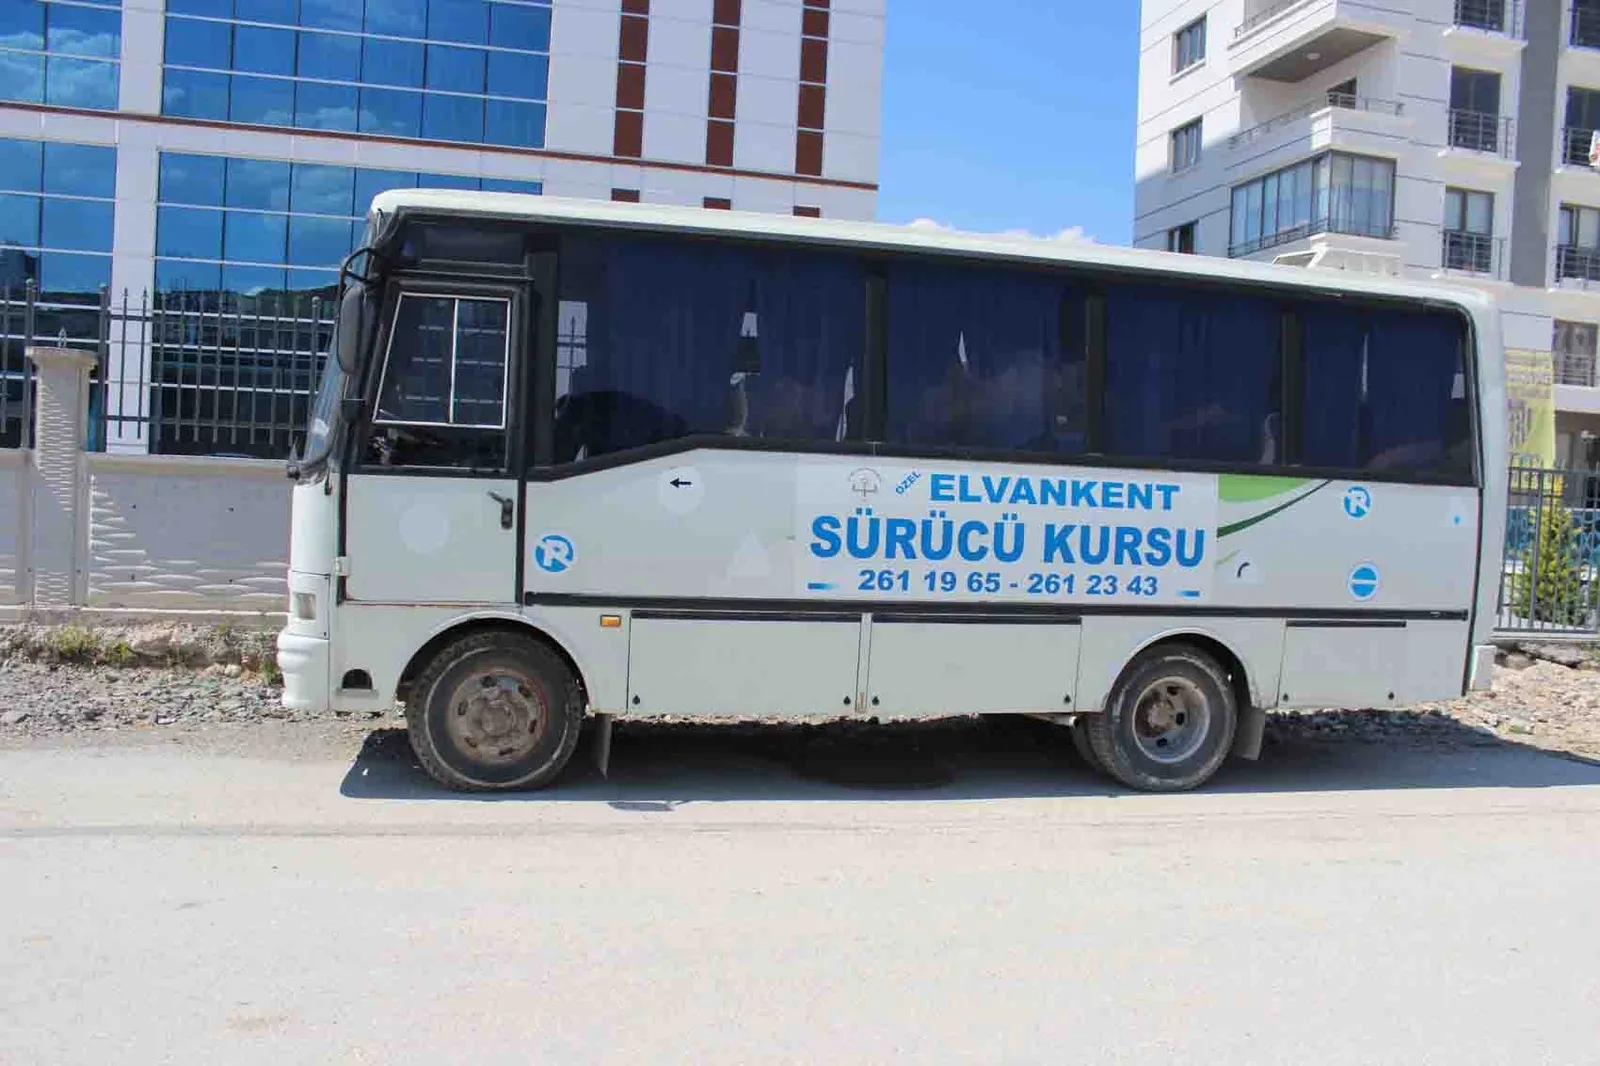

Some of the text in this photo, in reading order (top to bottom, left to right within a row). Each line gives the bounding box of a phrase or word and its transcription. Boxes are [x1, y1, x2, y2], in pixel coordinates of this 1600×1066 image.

[930, 473, 1180, 510] ELVANKENT
[810, 507, 1206, 567] SÜRÜCÜ KURSU
[858, 569, 910, 592] 261
[924, 570, 957, 593] 19
[967, 571, 1001, 594] 65
[1027, 572, 1075, 595] 261
[1086, 574, 1119, 596] 23
[1126, 575, 1159, 597] 43
